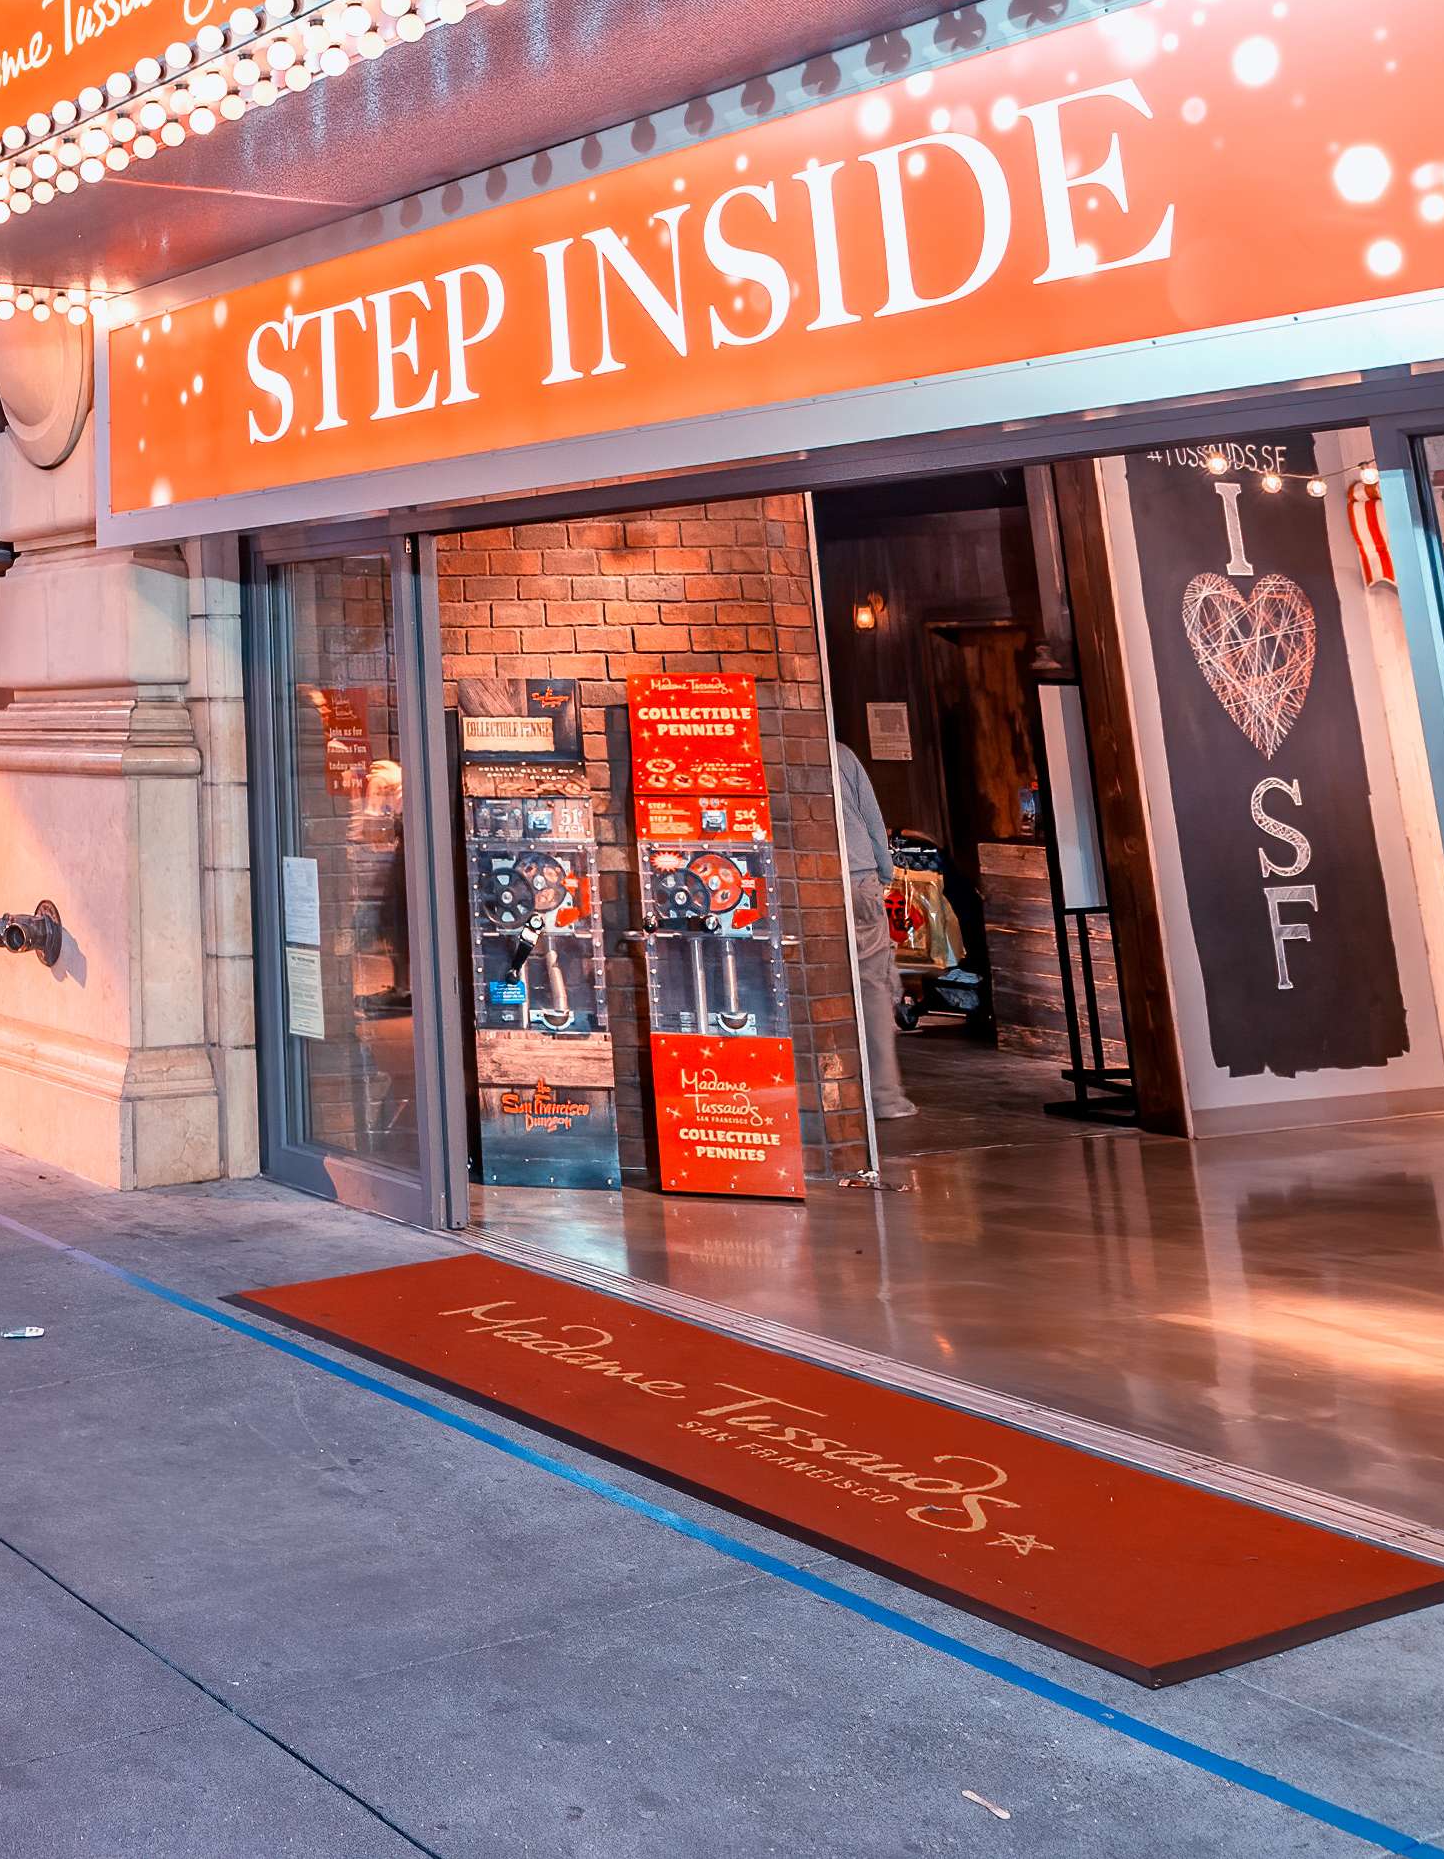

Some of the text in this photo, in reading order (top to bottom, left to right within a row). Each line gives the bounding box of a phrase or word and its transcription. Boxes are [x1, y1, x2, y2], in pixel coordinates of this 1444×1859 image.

[246, 78, 1177, 445] STEP INSIDE
[1214, 481, 1254, 577] I
[638, 707, 752, 720] COLLECTIBLE
[656, 723, 736, 737] PENNIES
[681, 1069, 752, 1093] Madame
[684, 1093, 766, 1127] Tussauds
[679, 1128, 781, 1146] COLLECTIBLE
[696, 1145, 766, 1162] PENNIES
[438, 1300, 1021, 1534] Madame Tussauds
[676, 1419, 901, 1505] SAN FRANCISCO
